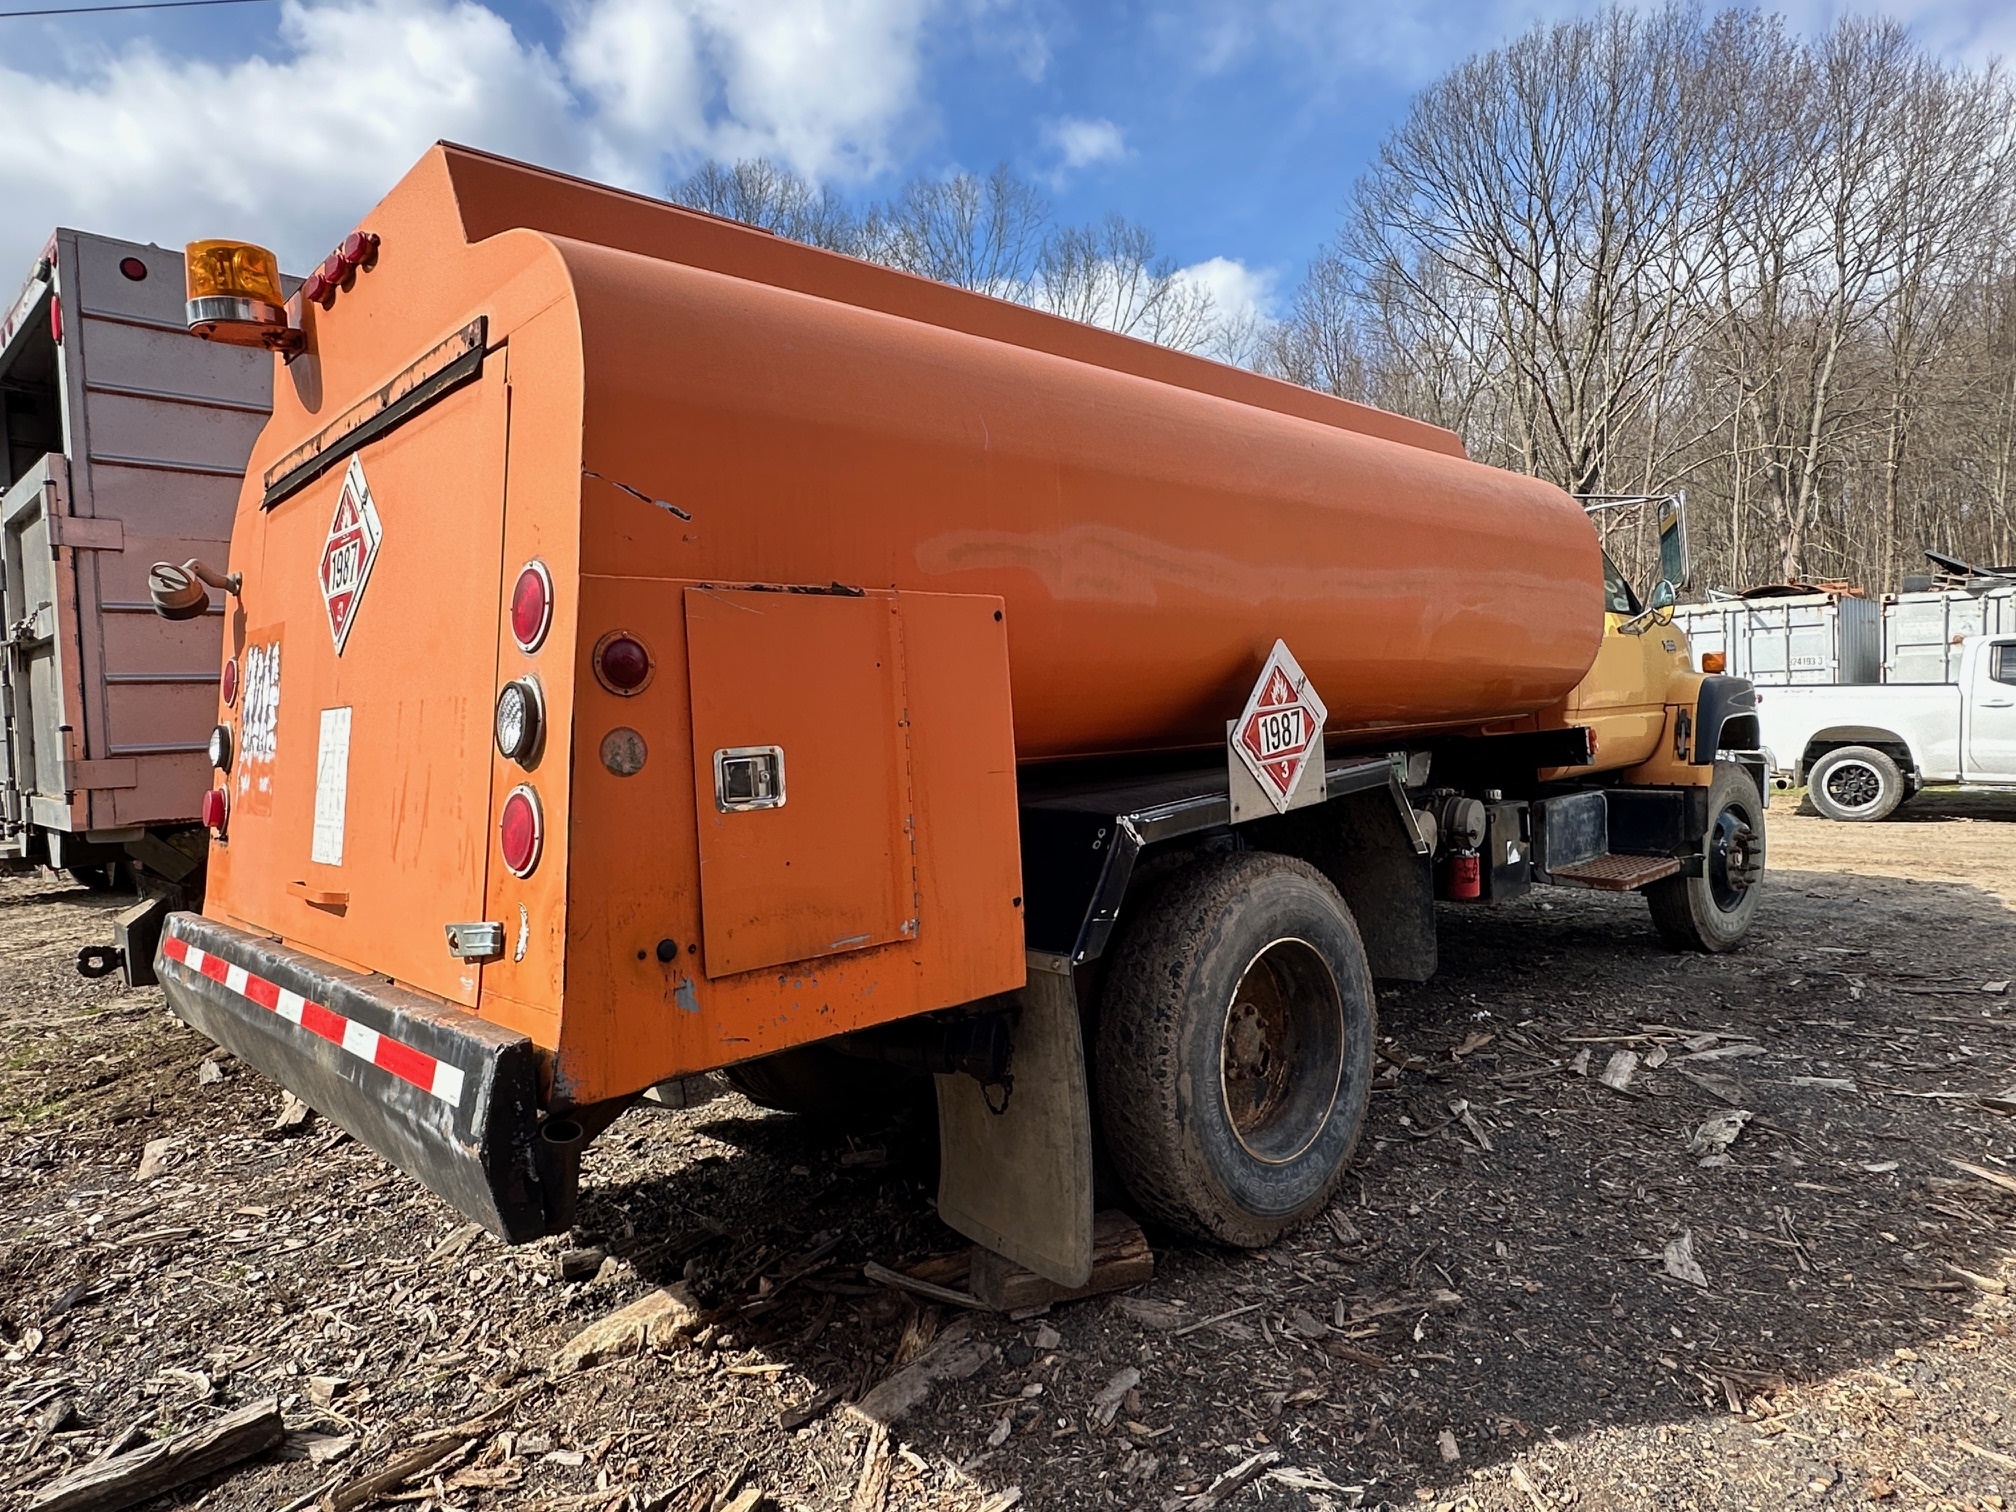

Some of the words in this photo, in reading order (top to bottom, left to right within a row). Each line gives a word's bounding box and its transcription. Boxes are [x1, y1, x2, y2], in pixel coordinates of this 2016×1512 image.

[332, 542, 358, 591] 1987
[336, 601, 344, 622] 3
[1261, 710, 1300, 753] 1987
[1281, 761, 1290, 778] 3
